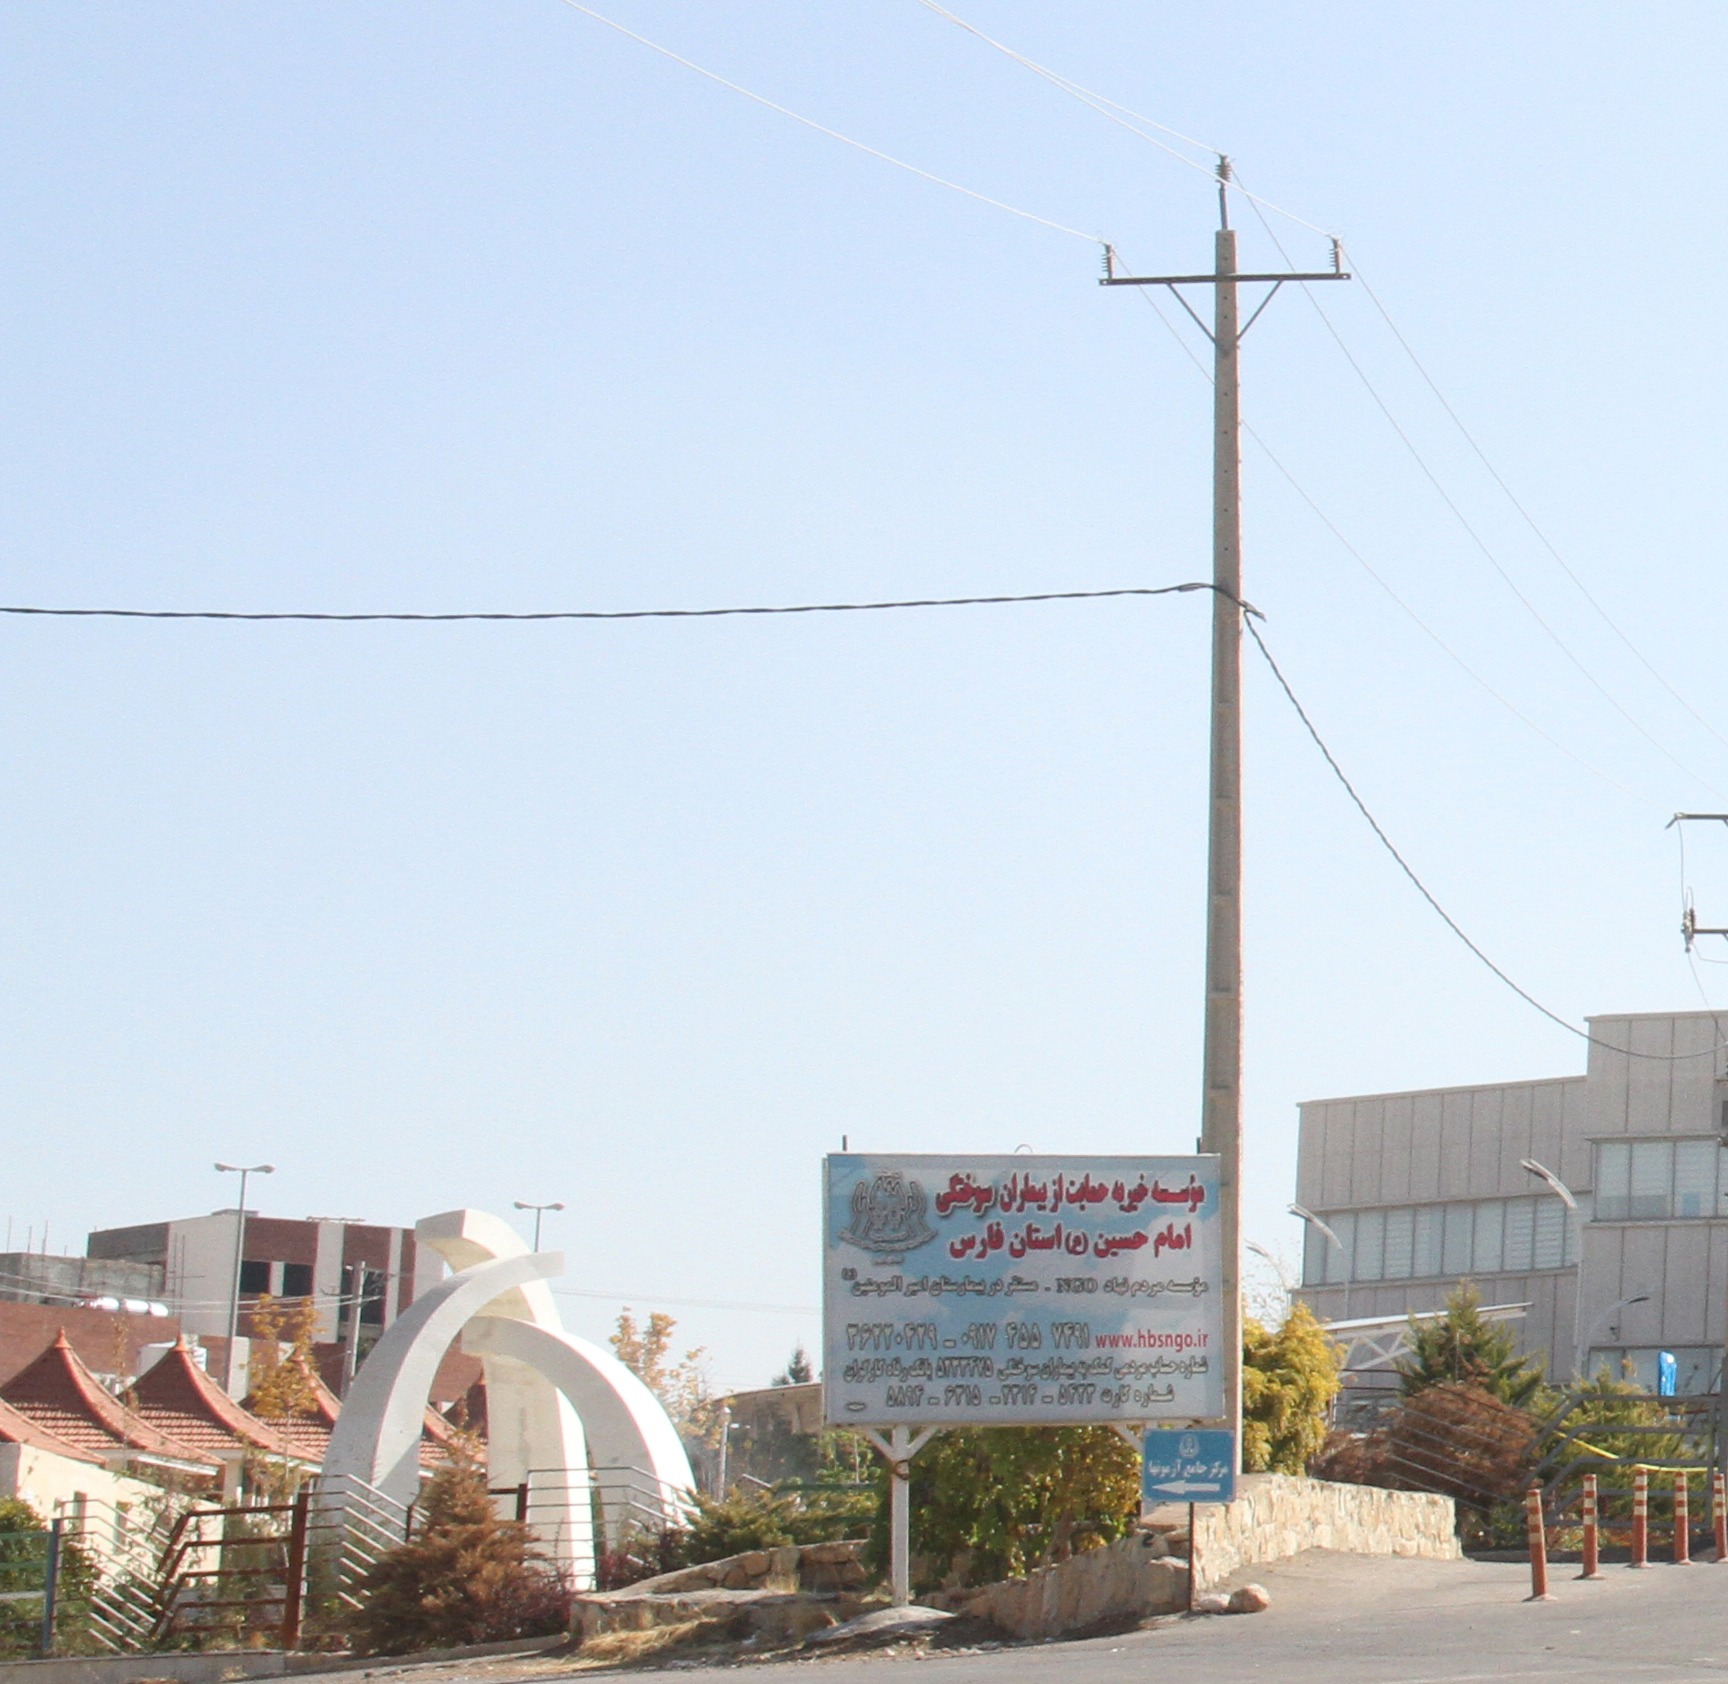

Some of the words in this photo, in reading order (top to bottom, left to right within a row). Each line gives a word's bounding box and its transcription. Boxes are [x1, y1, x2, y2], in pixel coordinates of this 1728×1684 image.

[935, 1173, 994, 1214] سوختگی
[1000, 1172, 1048, 1213] بیماران
[1049, 1172, 1063, 1213] از
[1065, 1172, 1110, 1212] حمایت
[1111, 1173, 1149, 1213] خیریه
[949, 1221, 1004, 1259] فارس
[1008, 1222, 1063, 1259] استان
[1093, 1230, 1149, 1258] حسین
[1153, 1222, 1192, 1259] امام
[988, 1279, 1003, 1297] در
[1055, 1277, 1098, 1294] NGO
[1095, 1328, 1210, 1353] www.hbsngo.ir
[1208, 1460, 1229, 1479] مرکز
